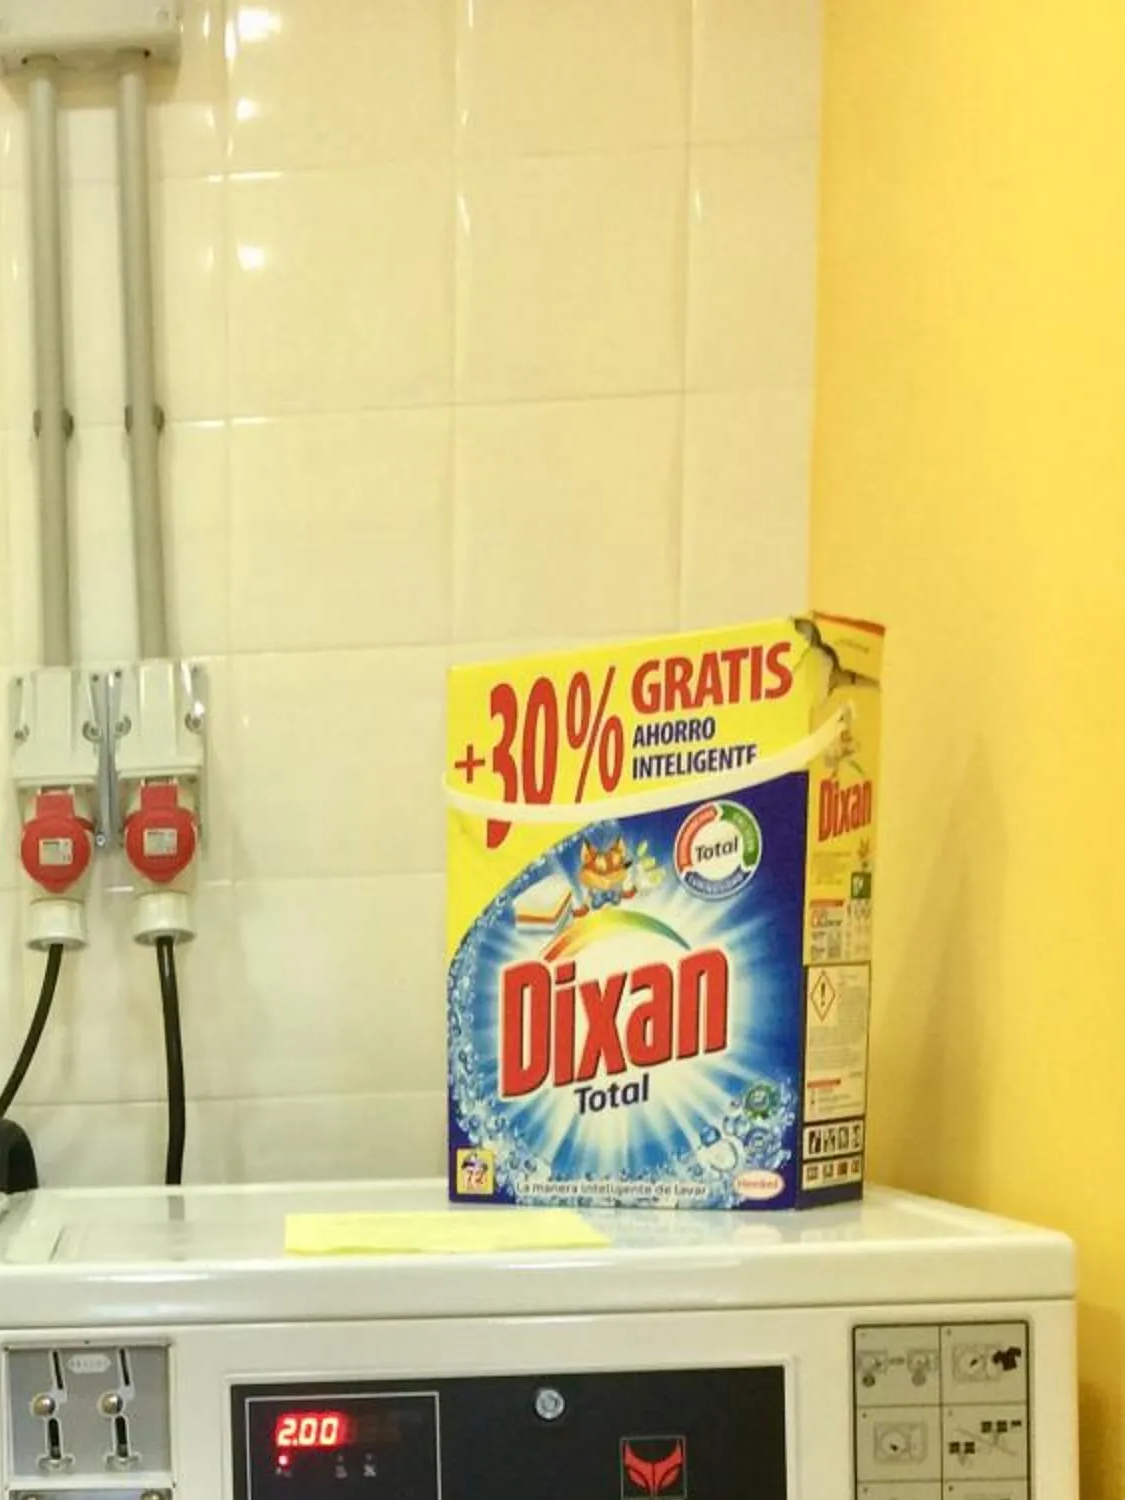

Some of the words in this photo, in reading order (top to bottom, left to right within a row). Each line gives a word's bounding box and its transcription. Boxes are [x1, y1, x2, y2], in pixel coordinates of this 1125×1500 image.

[631, 642, 792, 714] GRATIS
[632, 716, 716, 748] AHORRO
[632, 744, 758, 780] INTELIGENTE
[818, 779, 872, 842] Dixan
[695, 835, 739, 863] Total
[499, 947, 729, 1098] Dixan
[575, 1074, 650, 1114] Total
[532, 1181, 578, 1195] manera
[581, 1182, 652, 1198] inteligente
[655, 1182, 671, 1195] de
[277, 1416, 339, 1447] 2.00
